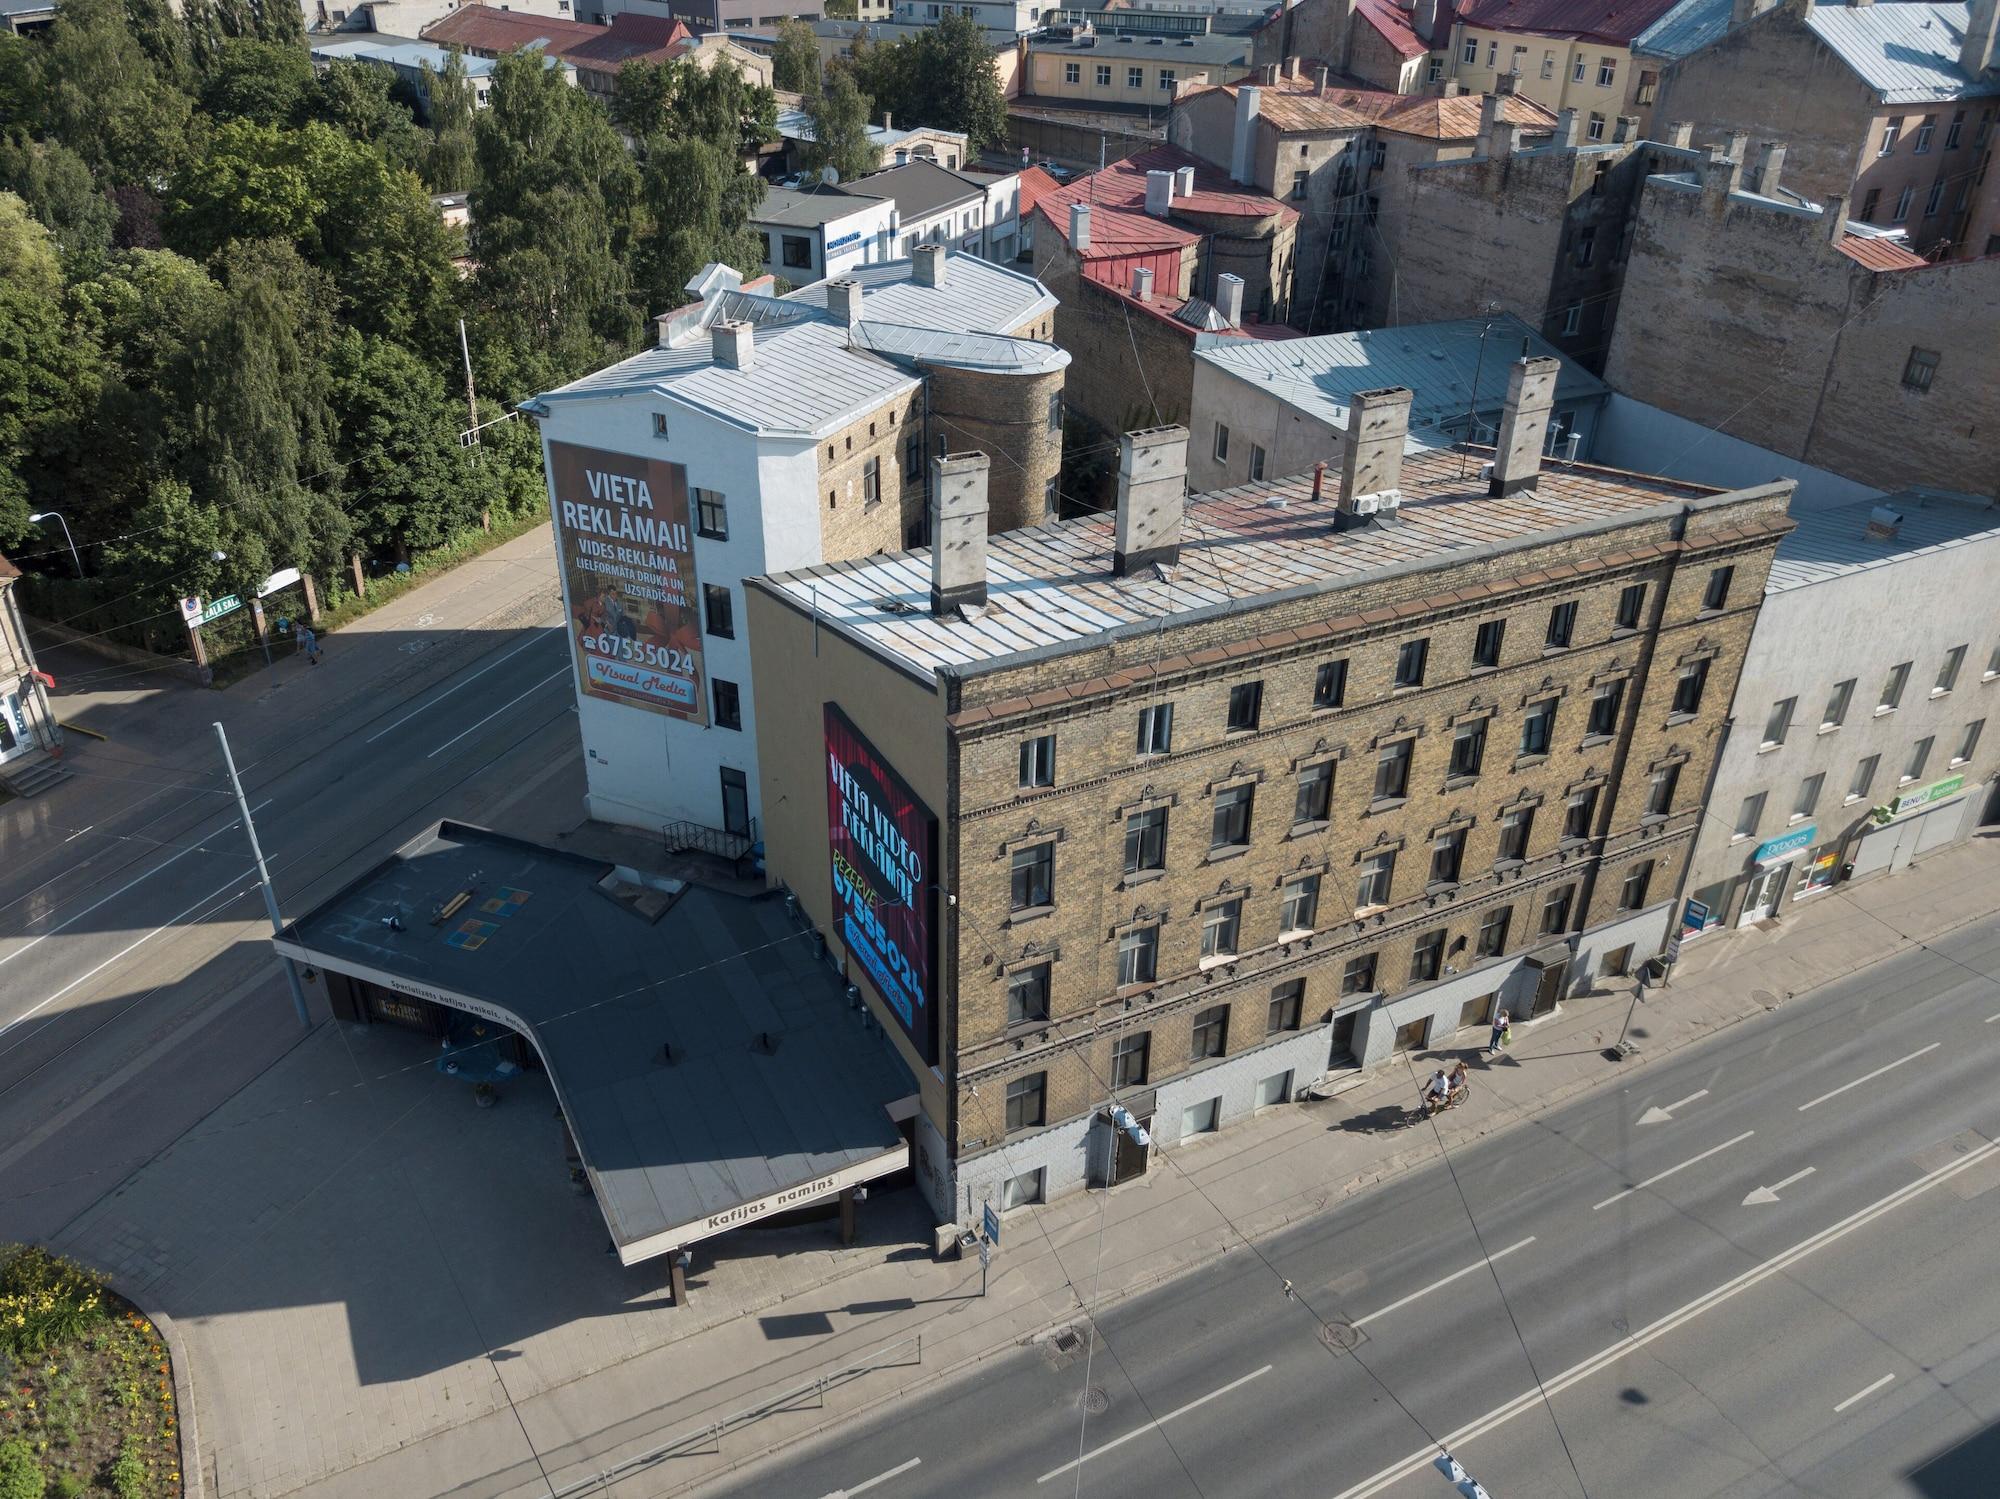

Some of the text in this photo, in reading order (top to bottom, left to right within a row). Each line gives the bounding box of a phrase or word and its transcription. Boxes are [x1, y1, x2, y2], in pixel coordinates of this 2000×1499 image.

[586, 469, 653, 510] VIETA
[562, 500, 688, 553] REKLĀMAI!
[576, 557, 685, 592] LIELFORMĀTA DRUKA UN
[578, 538, 678, 574] VIDES REKLĀMA
[624, 582, 686, 608] UZSTĀDĪŠANA
[597, 633, 695, 676] 67555024
[596, 662, 639, 685] Visual
[642, 671, 688, 698] Media
[829, 752, 922, 883] VIETA VIDEO
[1901, 794, 1920, 808] BENU
[842, 799, 914, 912] REKLĀMAI
[832, 848, 877, 908] REZERVĒ
[832, 864, 925, 1009] 67555024
[439, 994, 467, 1010] kafijas
[708, 1177, 835, 1230] Kafijas namiņš
